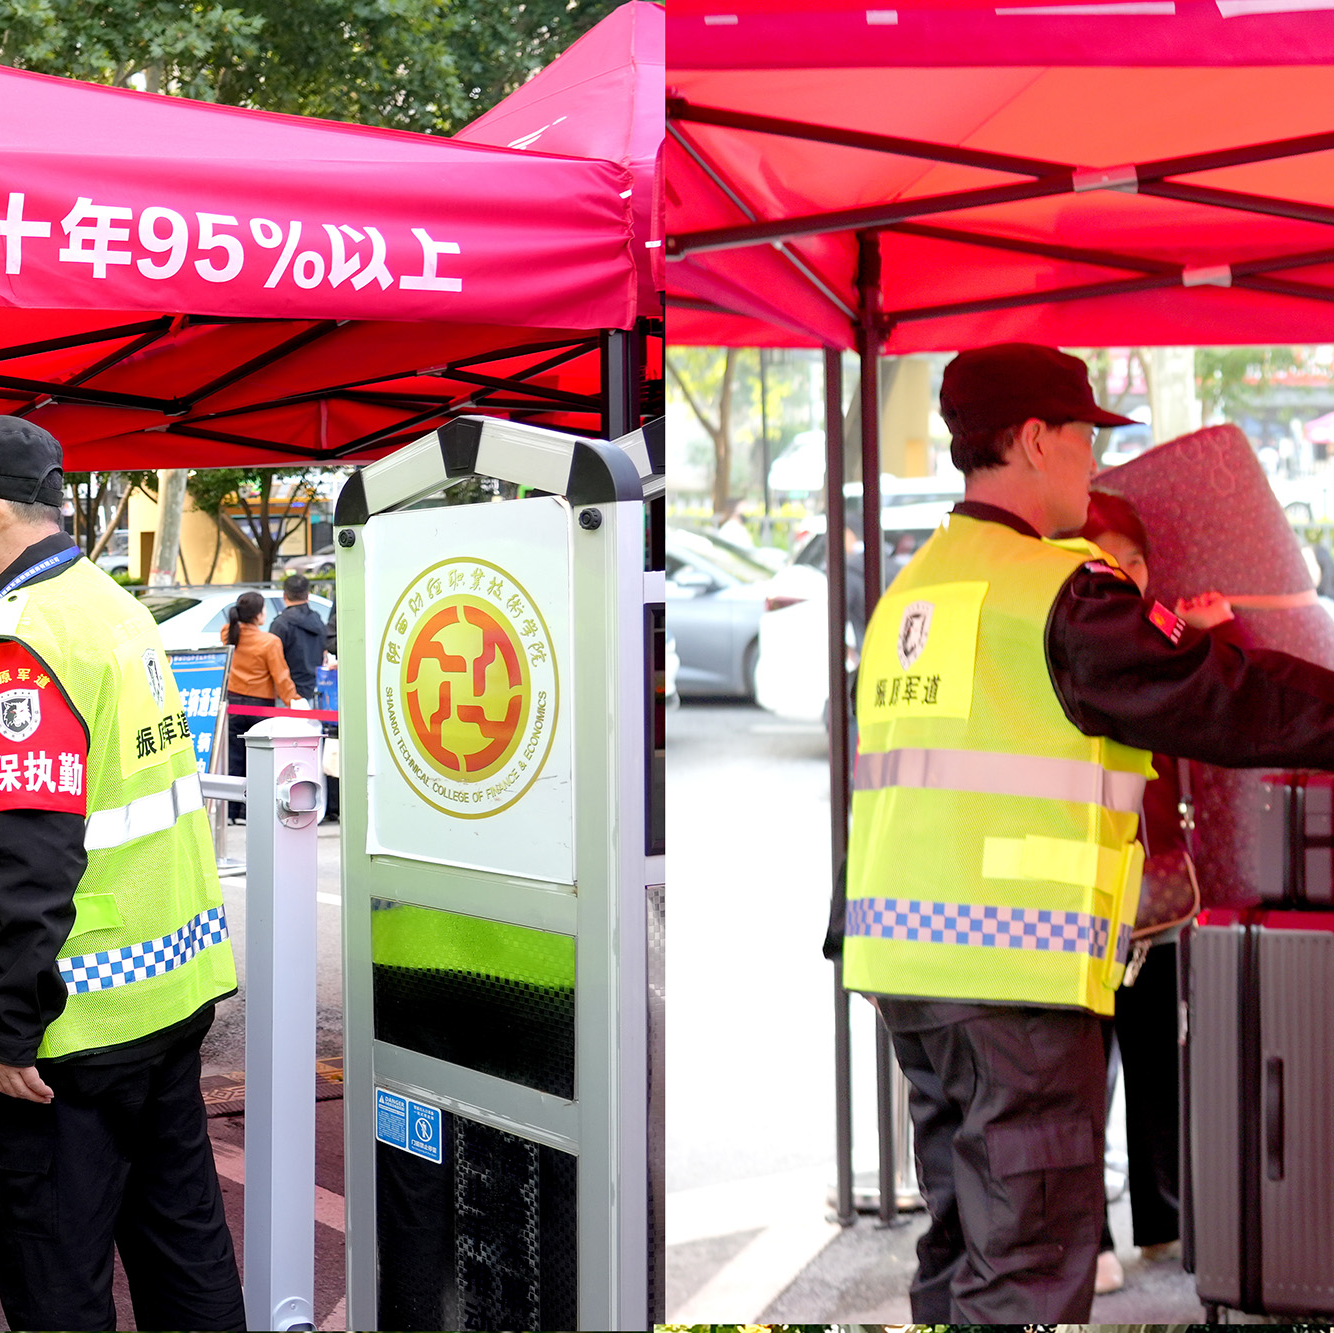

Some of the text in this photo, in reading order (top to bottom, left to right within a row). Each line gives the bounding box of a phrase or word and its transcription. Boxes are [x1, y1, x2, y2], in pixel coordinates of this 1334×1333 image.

[384, 686, 547, 804] SHAANXI TECHNICAL COLLEGE OF FINANCE & ECONOMICS
